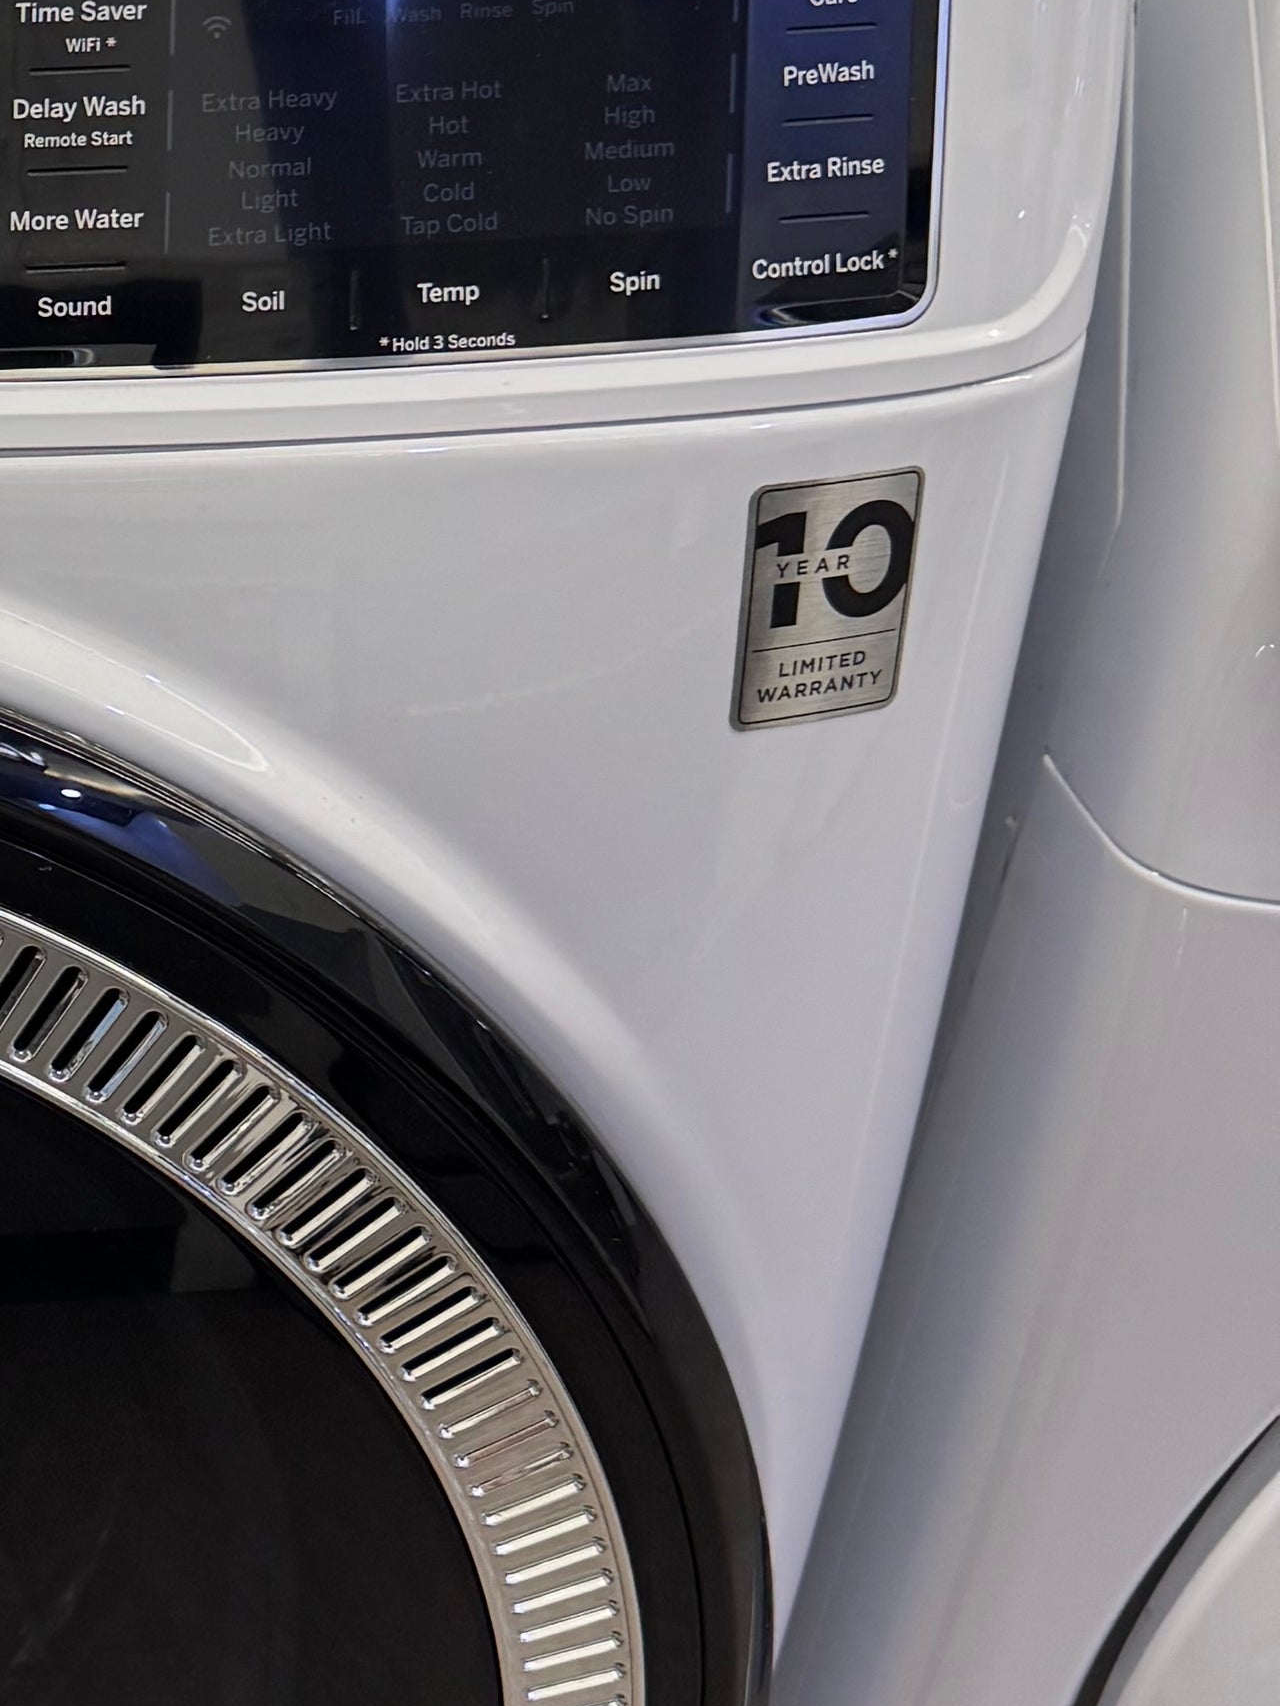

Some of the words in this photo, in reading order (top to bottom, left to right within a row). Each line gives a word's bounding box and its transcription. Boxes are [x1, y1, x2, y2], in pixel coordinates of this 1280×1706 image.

[16, 3, 74, 22] Time
[81, 1, 147, 21] Saver
[460, 3, 513, 19] Rinse
[531, 0, 575, 16] Spin
[66, 38, 100, 52] WiFi
[607, 74, 651, 92] Max
[784, 60, 874, 86] PreWash
[201, 92, 260, 113] Extra
[269, 90, 337, 110] Heavy
[397, 84, 454, 103] Extra
[462, 81, 501, 99] Hot
[14, 98, 77, 122] Delay
[83, 95, 145, 116] Wash
[605, 105, 655, 128] High
[236, 122, 304, 145] Heavy
[429, 116, 468, 134] Hot
[25, 133, 86, 147] Remote
[91, 131, 132, 145] Start
[585, 140, 674, 160] Medium
[228, 156, 312, 179] Normal
[417, 150, 482, 168] Warm
[768, 161, 821, 182] Extra
[828, 157, 884, 177] Rinse
[424, 181, 474, 202] Cold
[608, 175, 651, 192] Low
[241, 189, 299, 213] Light
[11, 211, 68, 230] More
[75, 209, 144, 229] Water
[400, 216, 440, 238] Tap
[447, 212, 497, 232] Cold
[586, 208, 616, 225] No
[624, 205, 673, 228] Spin
[209, 227, 266, 246] Extra
[273, 221, 332, 246] Light
[753, 254, 829, 279] Control
[417, 283, 479, 305] Temp
[610, 271, 659, 295] Spin
[38, 296, 111, 317] Sound
[243, 291, 284, 311] Soil
[433, 335, 443, 351] 3
[448, 331, 516, 350] Seconds
[755, 499, 915, 629] 10
[776, 555, 850, 578] YEAR
[779, 650, 866, 678] LIMITED
[757, 669, 882, 704] WARRANTY
